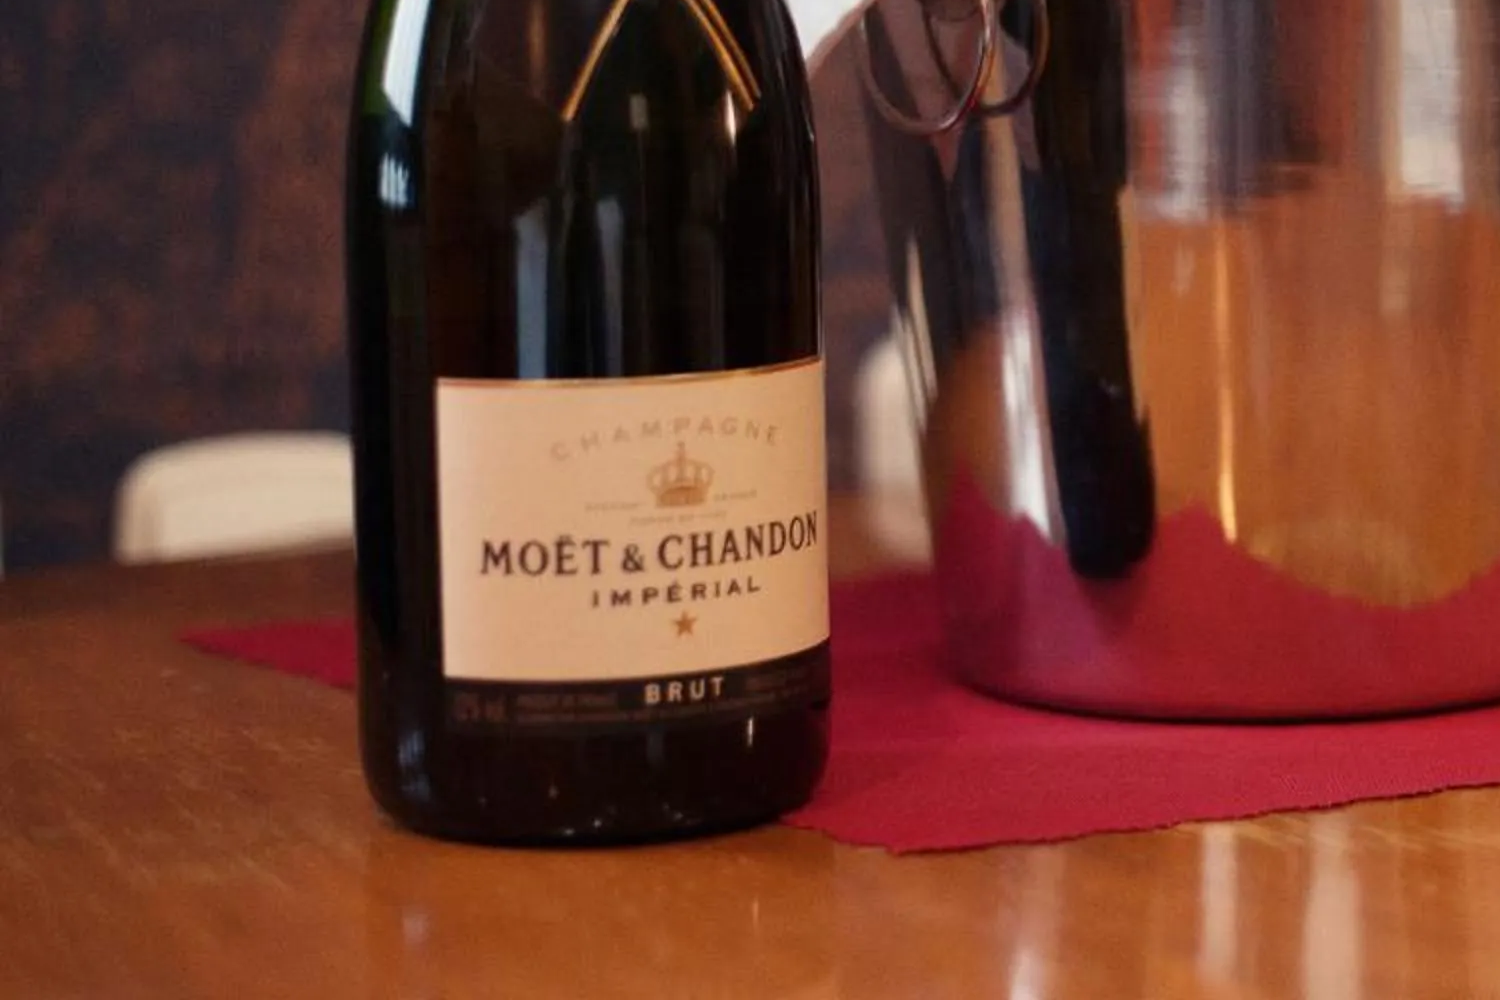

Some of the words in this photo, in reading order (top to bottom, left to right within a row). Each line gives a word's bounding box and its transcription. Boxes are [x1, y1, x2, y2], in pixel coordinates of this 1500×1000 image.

[550, 415, 783, 463] CHAMPAGNE
[479, 534, 611, 577] MOËT
[621, 542, 646, 574] &
[656, 509, 821, 571] CHANDON
[591, 579, 763, 609] IMPÉRIAL
[643, 675, 727, 706] BRUT
